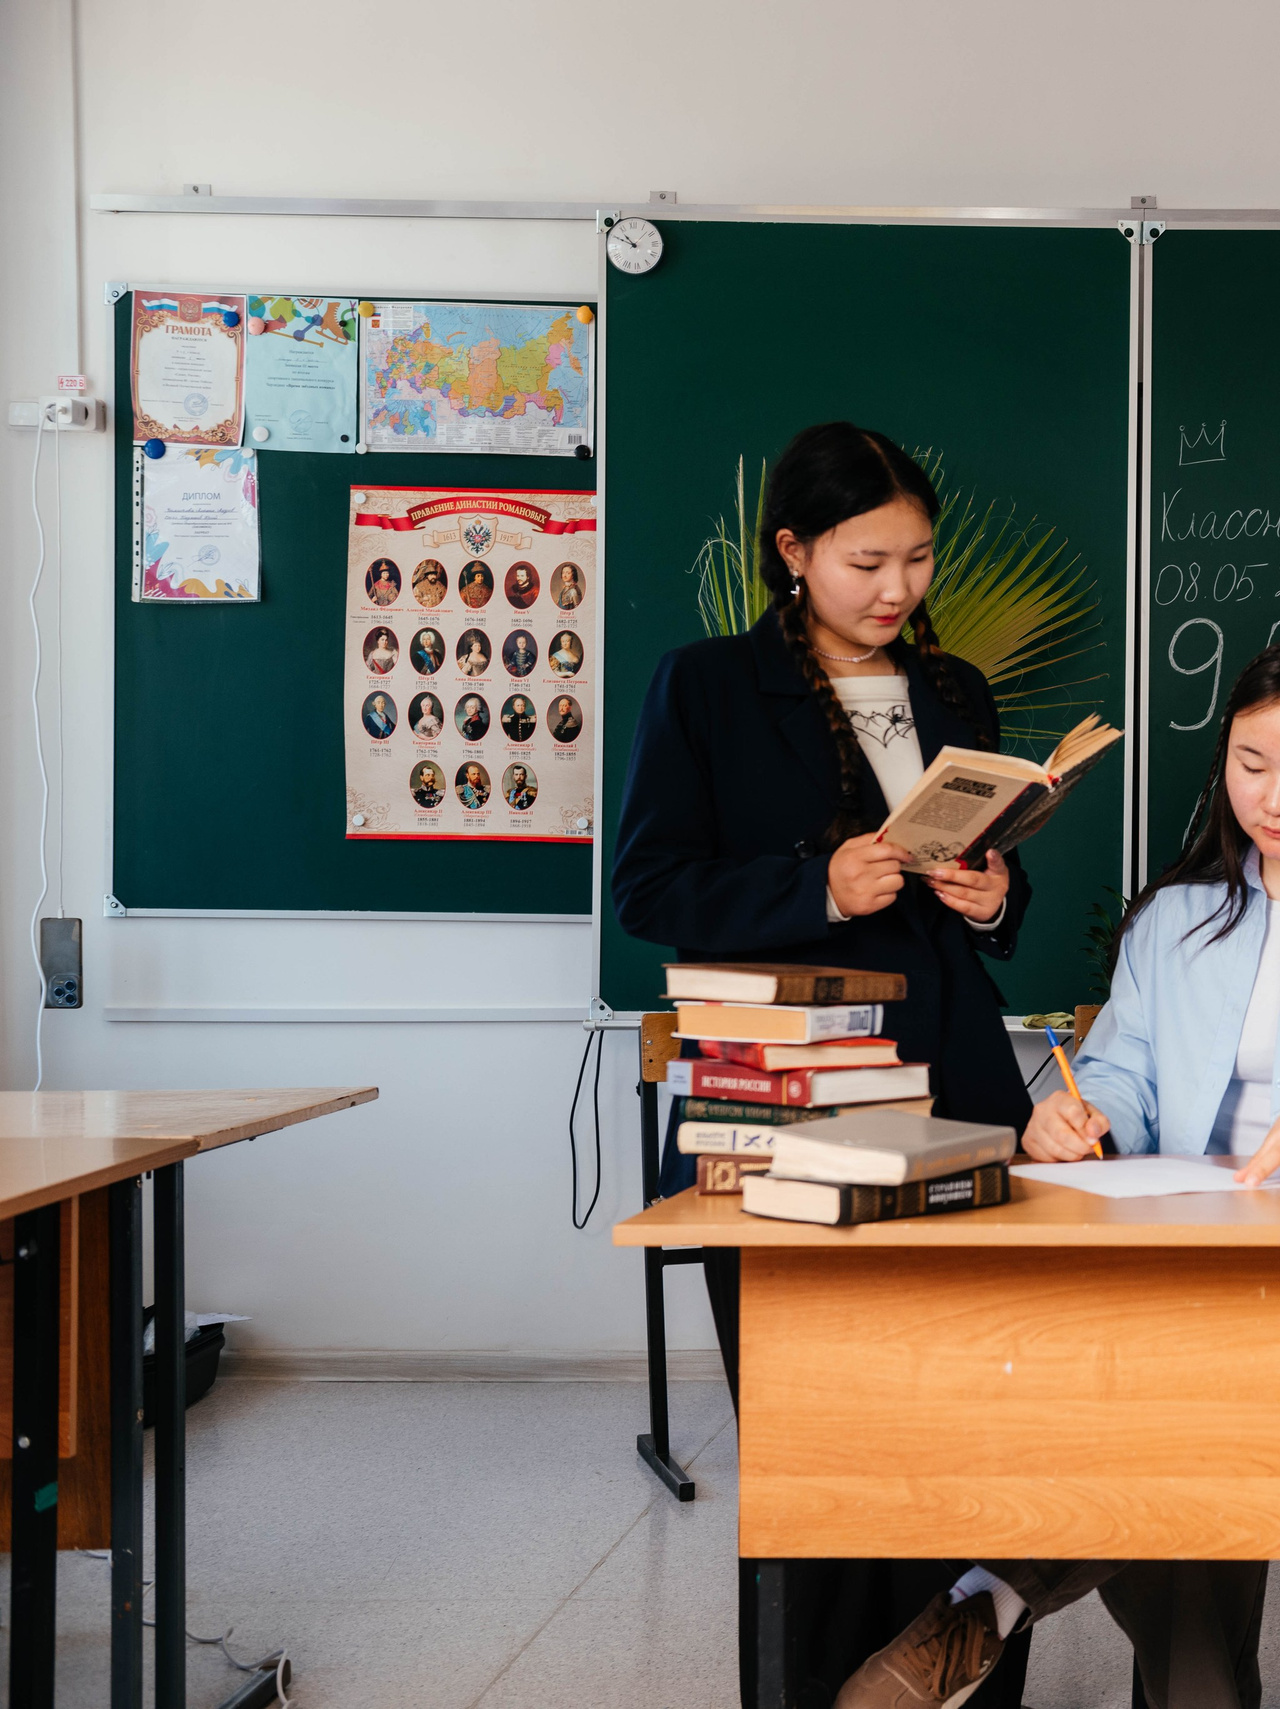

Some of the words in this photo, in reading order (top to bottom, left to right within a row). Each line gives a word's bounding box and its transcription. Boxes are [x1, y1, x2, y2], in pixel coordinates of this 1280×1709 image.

[166, 325, 212, 336] ГРАМОТА
[65, 379, 77, 387] 220
[182, 492, 221, 501] ДИПЛОМ
[411, 502, 454, 521] ПРАВЛЕНИЕ
[455, 500, 498, 510] ДИНАСТИИ
[498, 502, 547, 524] РОМАНОВЫХ
[443, 533, 456, 541] 1613
[500, 533, 514, 541] 1917
[1168, 617, 1224, 731] 9
